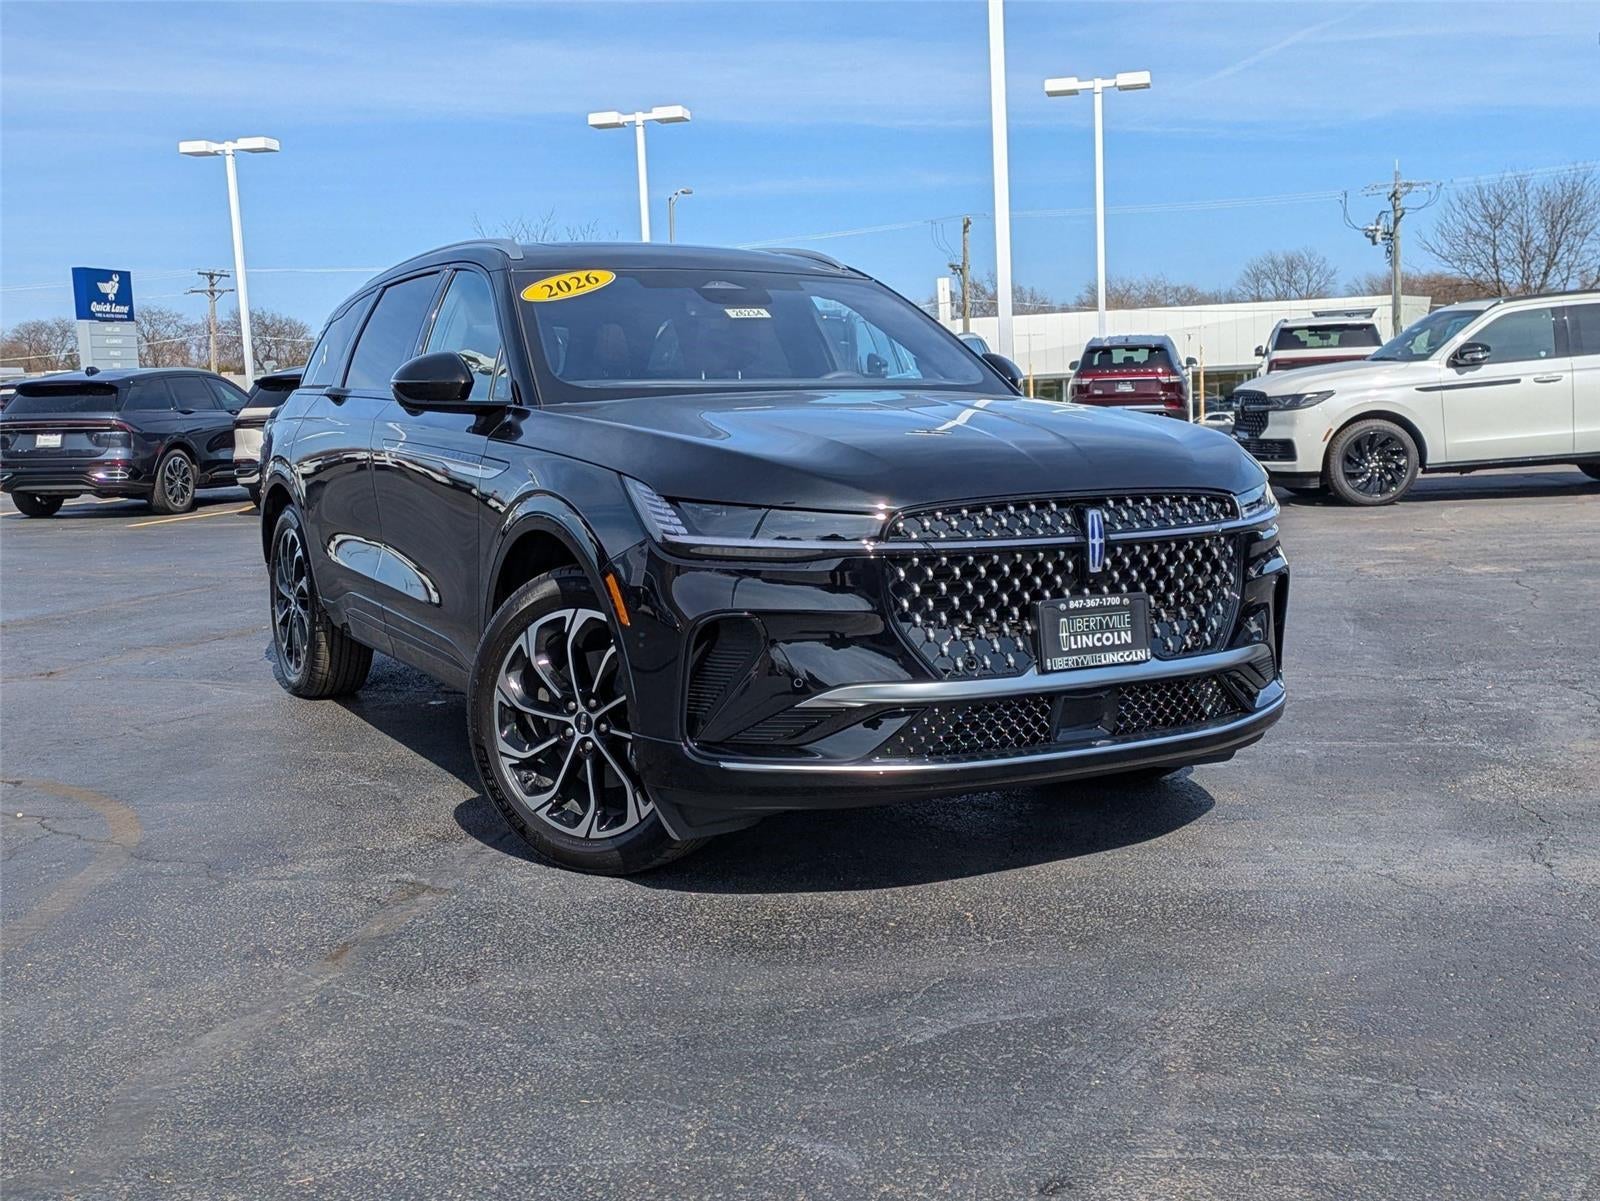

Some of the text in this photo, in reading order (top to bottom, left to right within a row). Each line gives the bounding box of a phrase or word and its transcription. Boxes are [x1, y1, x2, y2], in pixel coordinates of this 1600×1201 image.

[540, 272, 600, 298] 2026
[91, 301, 129, 313] Quick Lane
[1069, 597, 1121, 609] 847-367-1700
[1069, 614, 1131, 633] LIBERTYVILLE
[1070, 631, 1132, 649] LINCOLN
